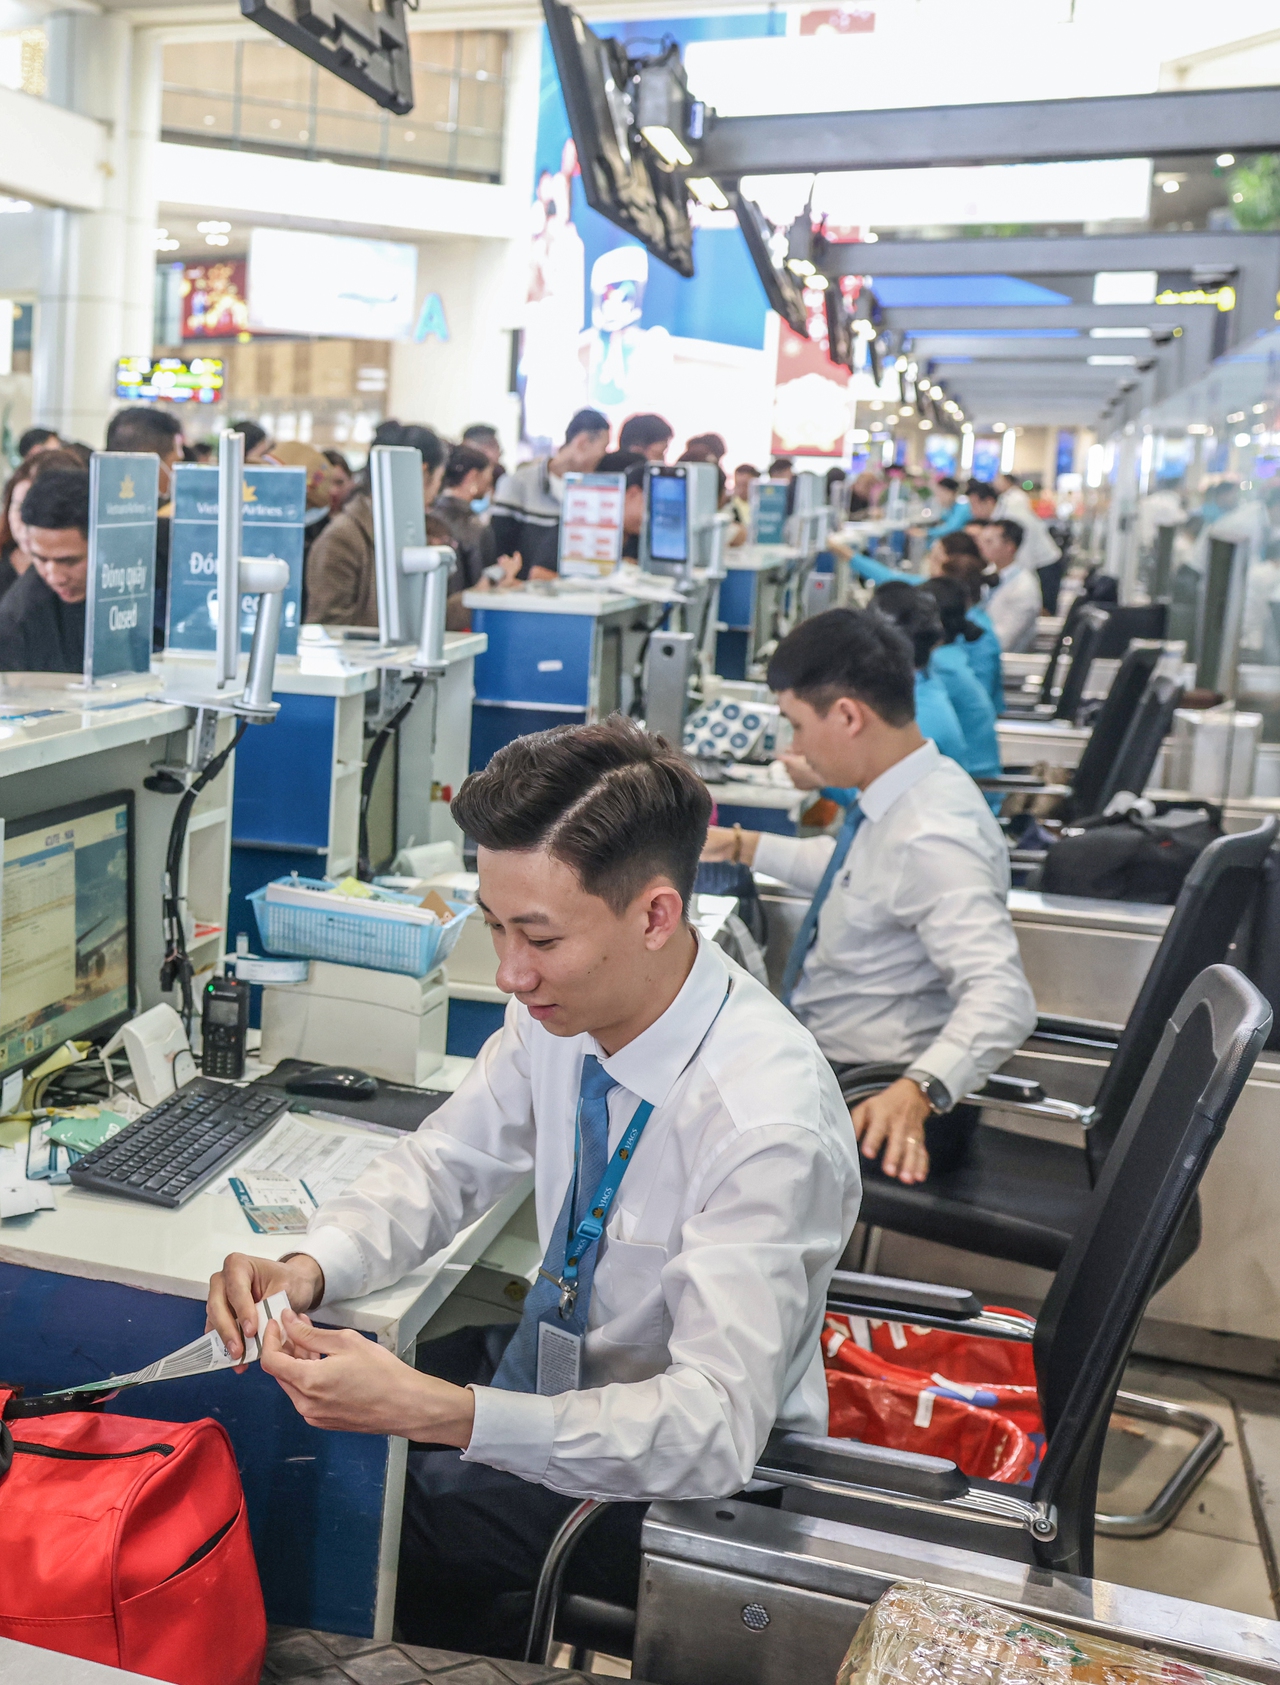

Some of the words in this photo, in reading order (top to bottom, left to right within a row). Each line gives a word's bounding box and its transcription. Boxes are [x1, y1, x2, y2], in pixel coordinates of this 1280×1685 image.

[413, 292, 450, 343] A
[109, 602, 138, 631] Closed
[625, 1127, 638, 1149] VIAGS
[599, 1187, 613, 1208] VIAGS
